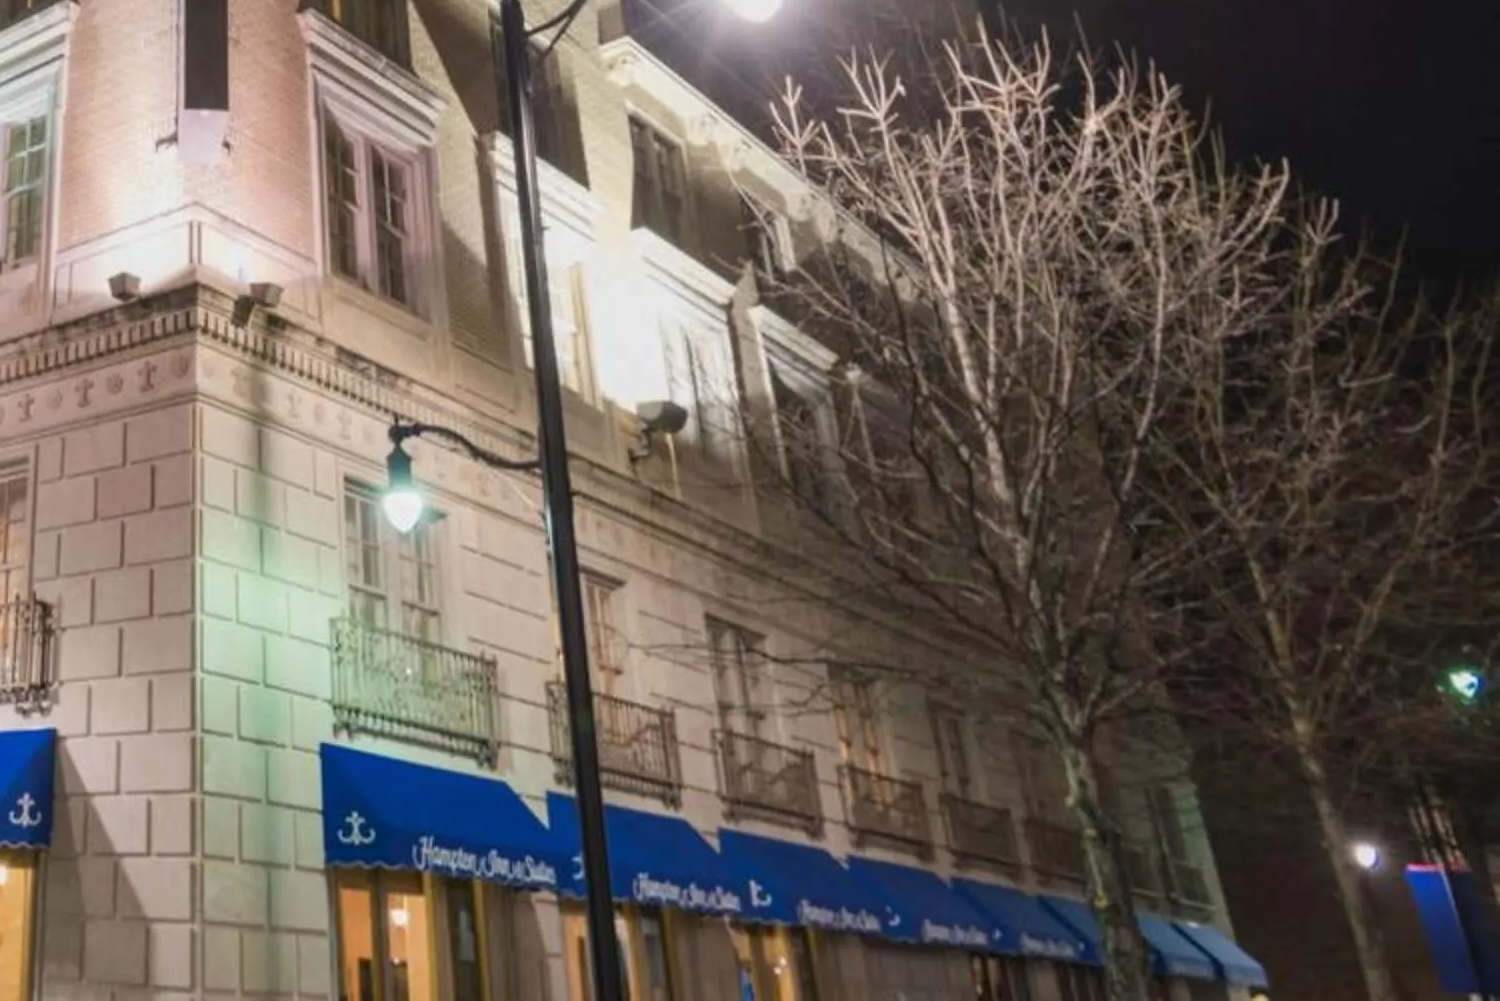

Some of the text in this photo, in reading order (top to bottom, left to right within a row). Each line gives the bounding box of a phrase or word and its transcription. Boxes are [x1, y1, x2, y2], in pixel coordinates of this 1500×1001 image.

[412, 835, 478, 877] Hampton
[479, 848, 510, 878] Inn
[523, 854, 557, 885] Suites
